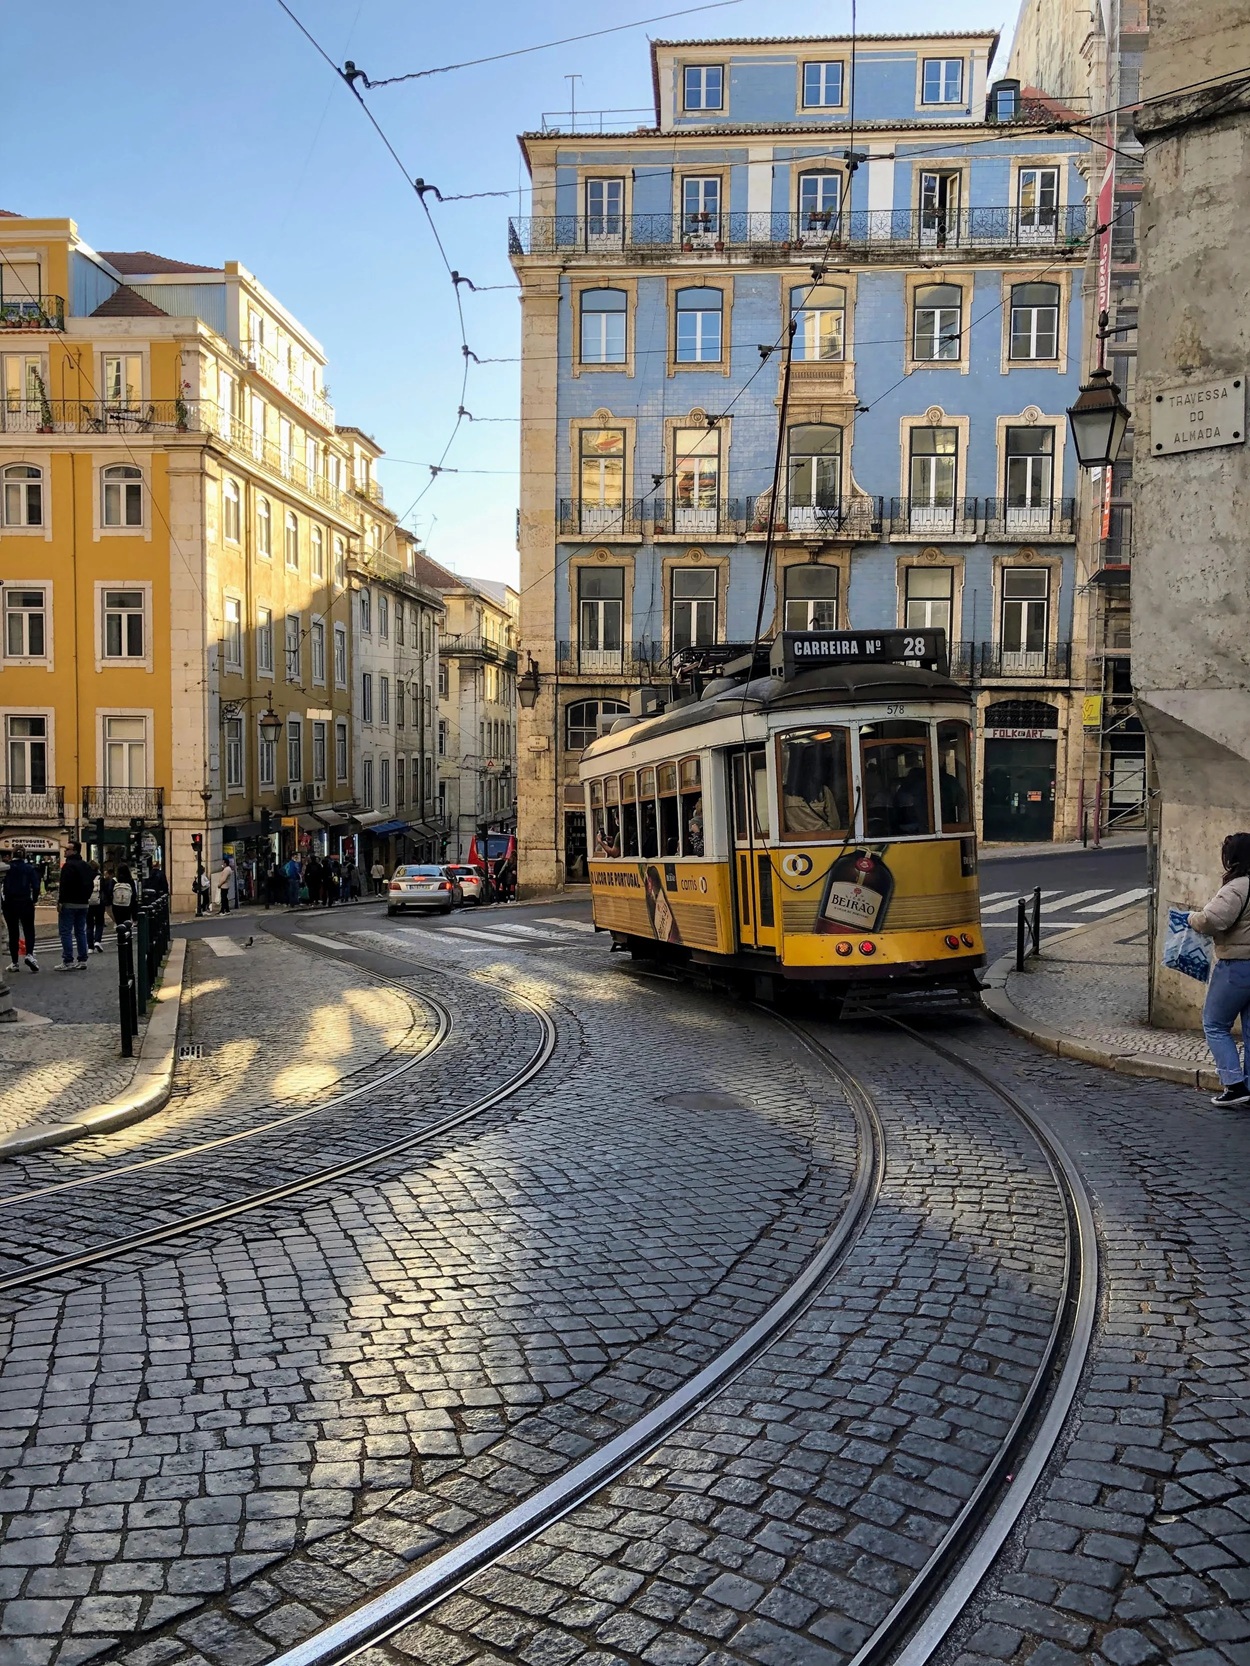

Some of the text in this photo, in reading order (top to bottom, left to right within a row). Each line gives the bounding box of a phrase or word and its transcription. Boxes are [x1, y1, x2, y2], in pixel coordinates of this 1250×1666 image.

[1169, 387, 1228, 408] TRAVESSA
[1190, 410, 1204, 422] DO
[1174, 426, 1221, 444] ALMADA
[794, 637, 926, 656] CARREIRA Nº 28
[886, 704, 905, 714] 578
[992, 730, 1018, 738] FOLK
[1026, 729, 1044, 738] ART
[594, 872, 607, 886] LICOR
[607, 872, 614, 886] DE
[614, 872, 640, 888] PORTUGAL
[831, 894, 875, 916] BEIRÃO
